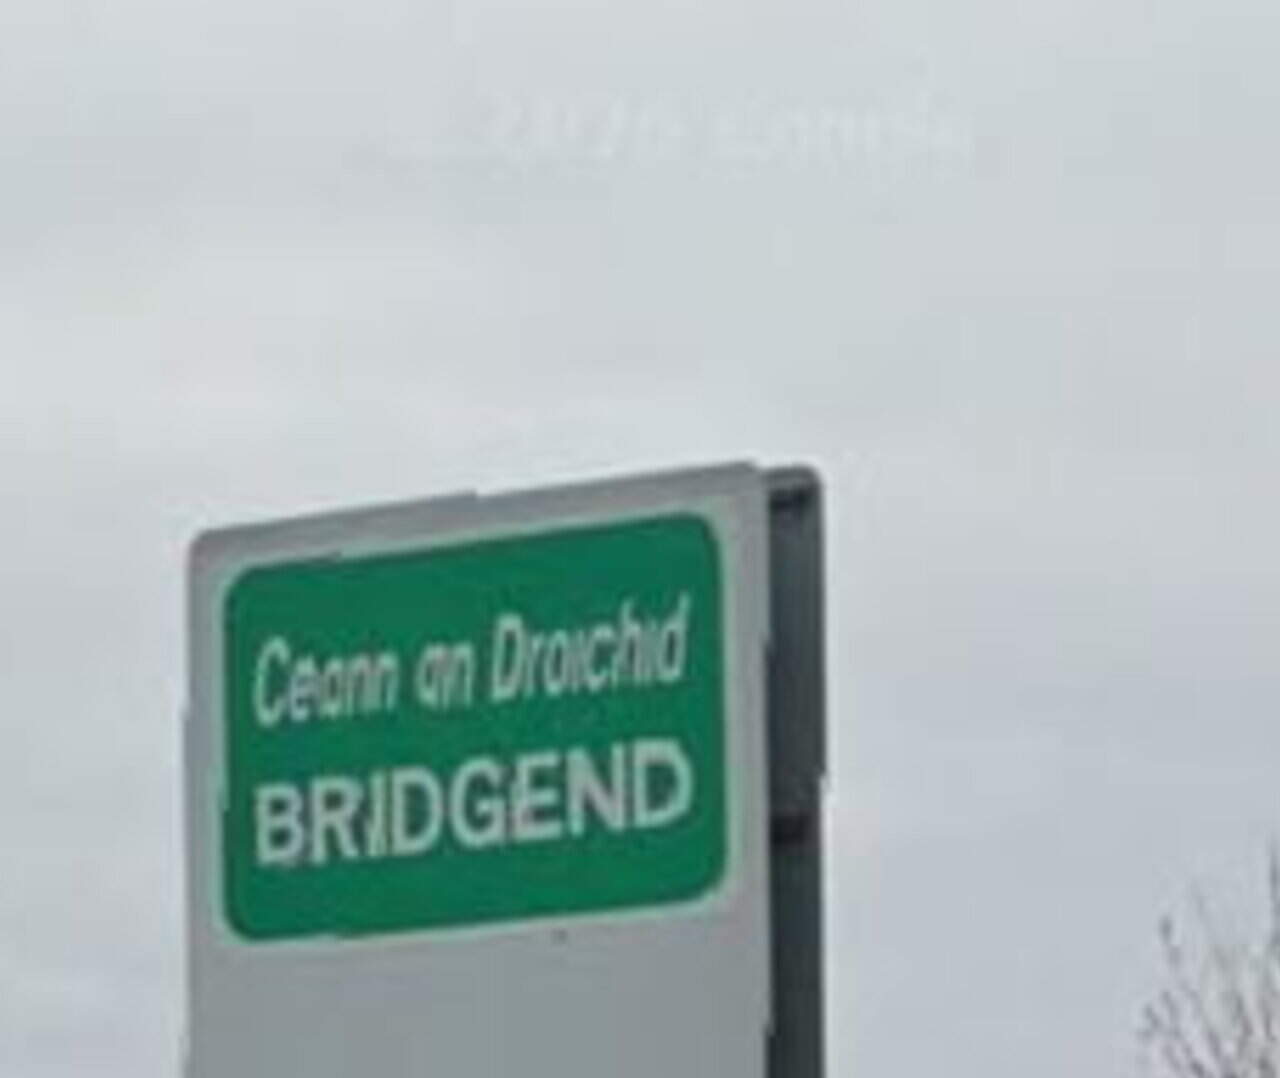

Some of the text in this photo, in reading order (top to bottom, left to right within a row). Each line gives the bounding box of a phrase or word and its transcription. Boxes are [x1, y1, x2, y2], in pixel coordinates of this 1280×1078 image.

[253, 592, 693, 727] Ceann an Droichid
[252, 736, 695, 868] BRIDGEND
